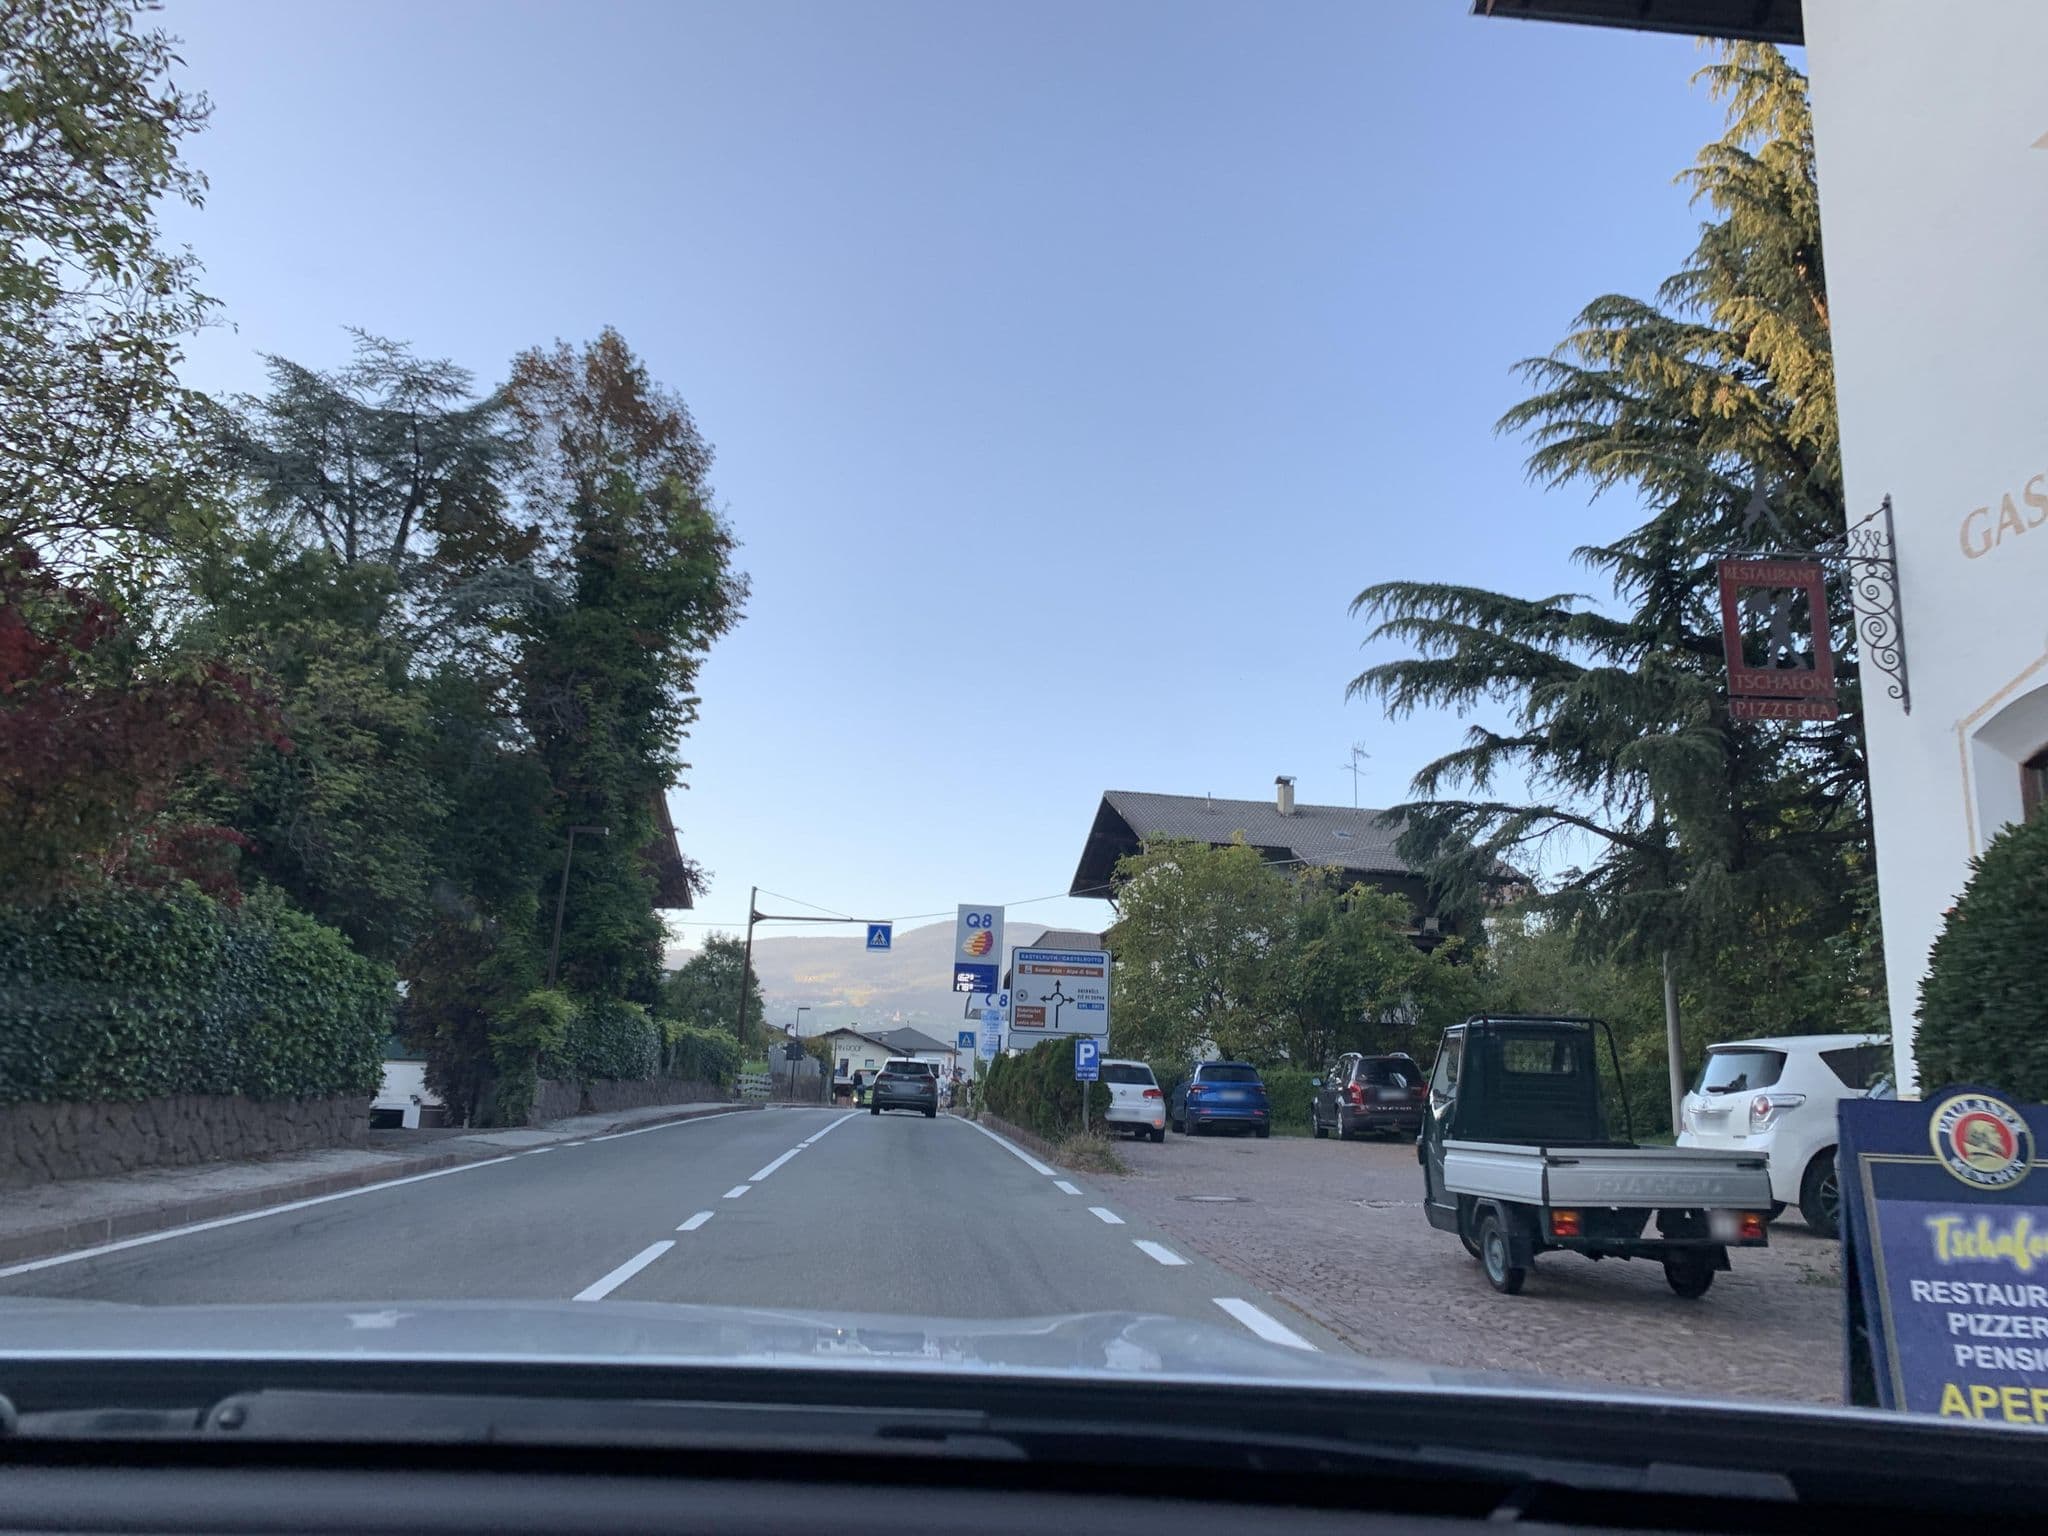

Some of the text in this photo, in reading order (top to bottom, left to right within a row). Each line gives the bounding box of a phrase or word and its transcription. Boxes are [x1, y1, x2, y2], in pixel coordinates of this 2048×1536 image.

[1960, 473, 2048, 559] GAS
[1723, 566, 1817, 582] RESTAURANT
[1735, 674, 1829, 690] TSCHAFON
[1736, 702, 1831, 718] PIZZERIA
[966, 912, 992, 929] Q8
[1080, 1043, 1095, 1065] P
[1938, 1099, 2025, 1134] PAULANER
[1926, 1216, 2048, 1270] Tschafo
[1910, 1279, 2048, 1308] RESTAUR
[1947, 1312, 2048, 1340] PIZZER
